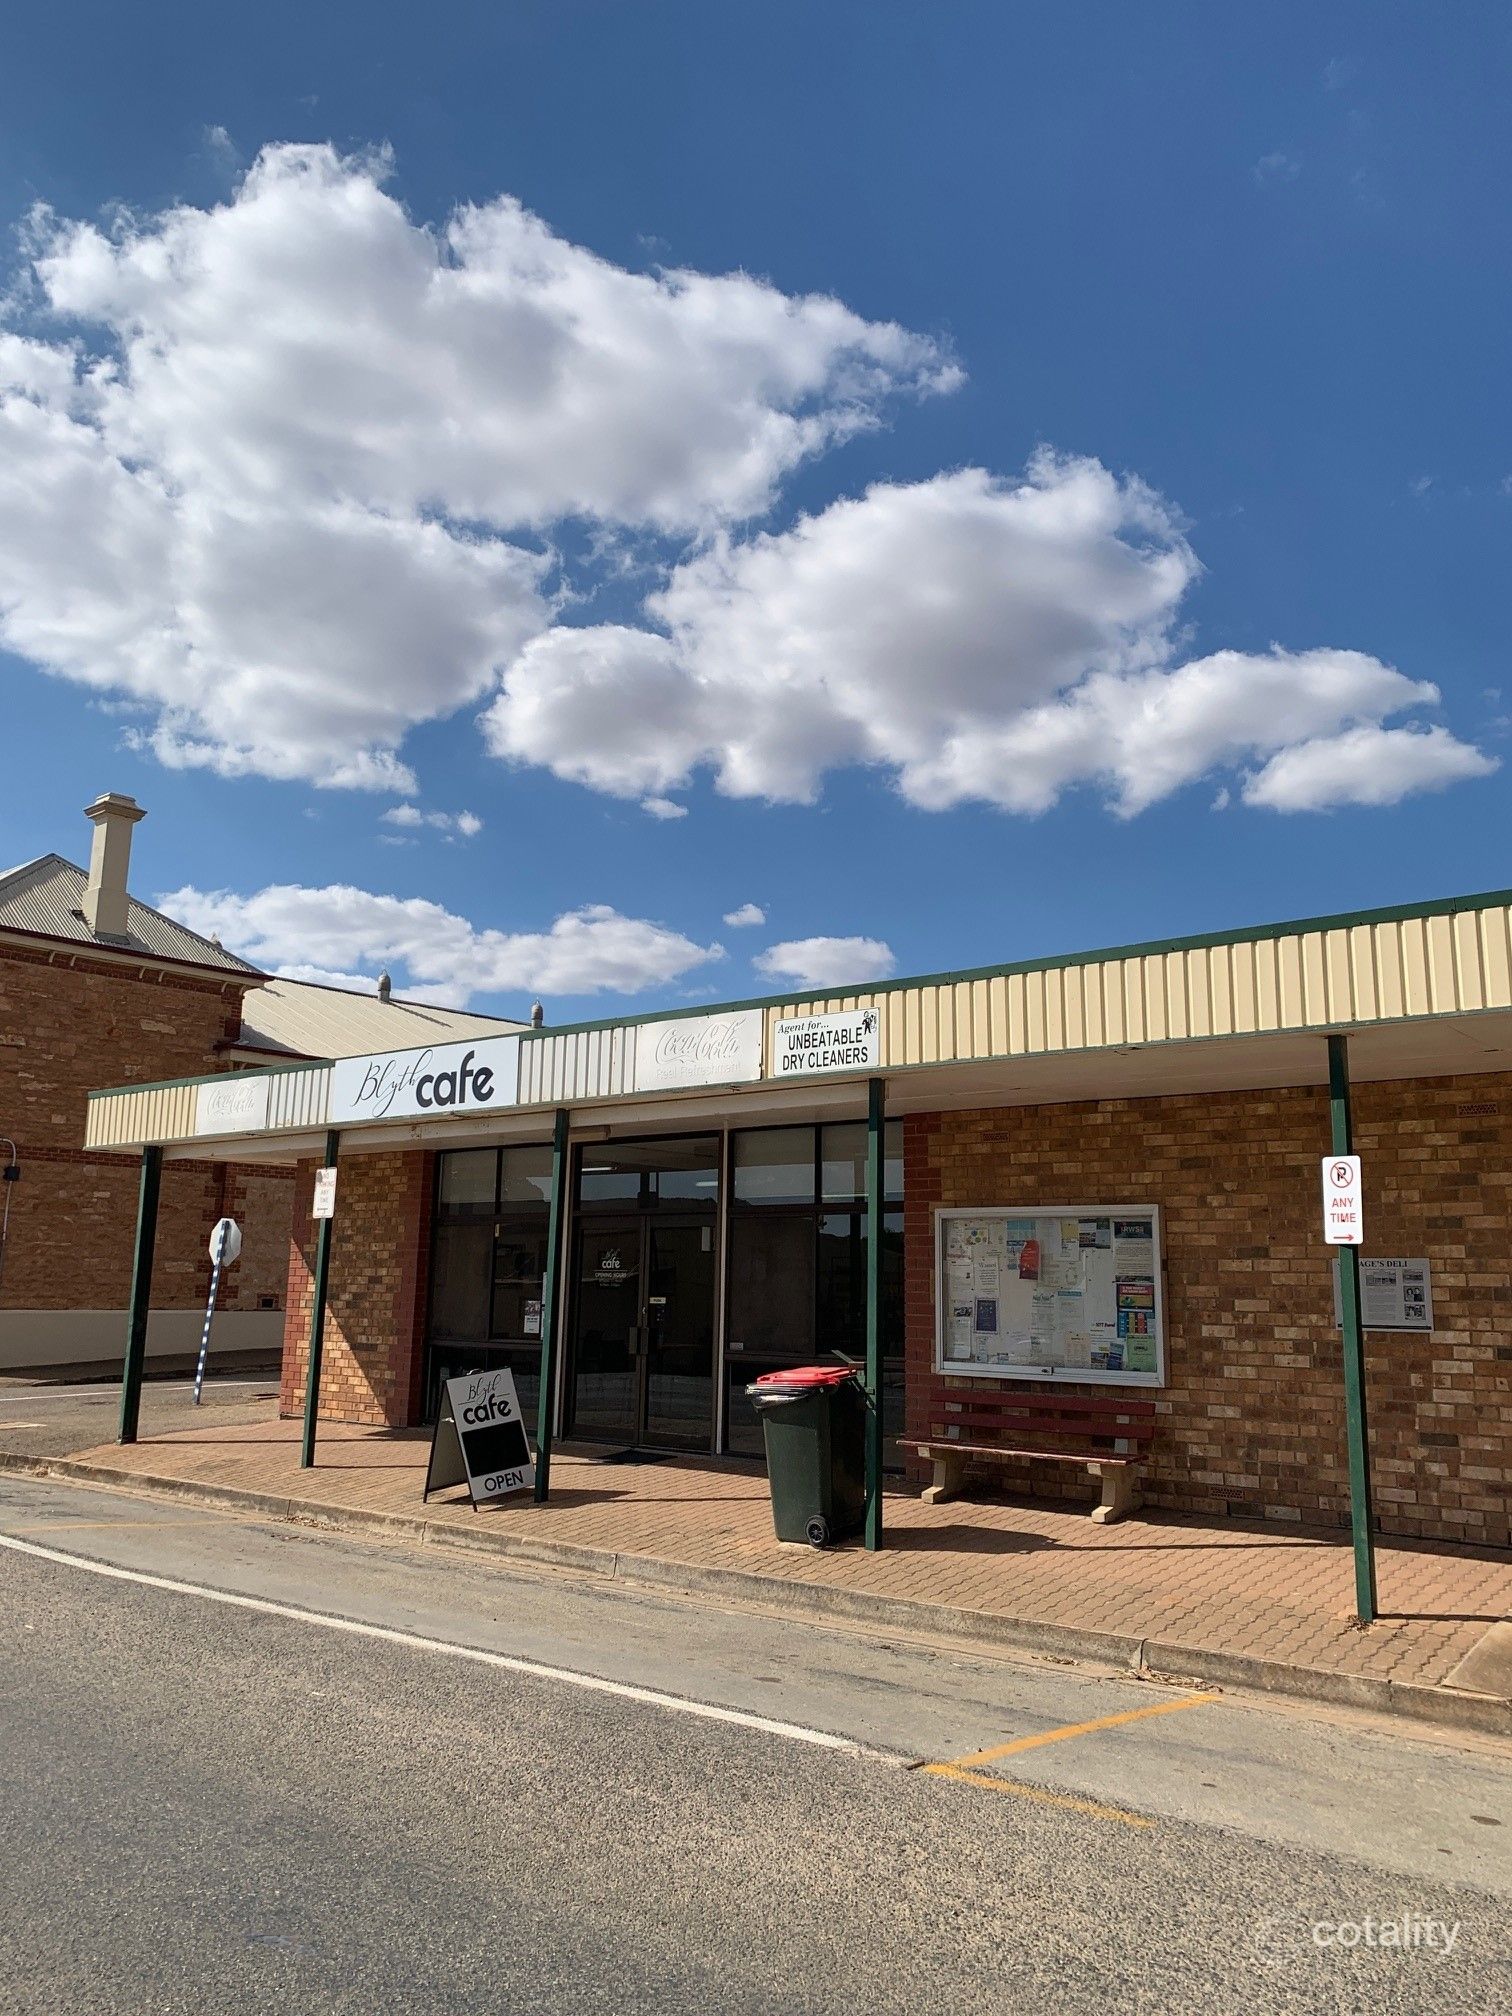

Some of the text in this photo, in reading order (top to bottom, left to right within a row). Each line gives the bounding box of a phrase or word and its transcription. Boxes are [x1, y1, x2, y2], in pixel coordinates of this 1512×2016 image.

[778, 1020, 829, 1034] Agent for...
[788, 1026, 863, 1051] UNBEATABLE
[782, 1046, 868, 1071] DRY CLEANERS
[350, 1049, 495, 1118] Blyth cafe
[1332, 1197, 1354, 1208] ANY
[1330, 1212, 1357, 1223] TIME
[602, 1257, 620, 1269] cafe
[1387, 1260, 1408, 1268] DELI
[463, 1393, 512, 1425] cafe
[484, 1470, 524, 1492] OPEN
